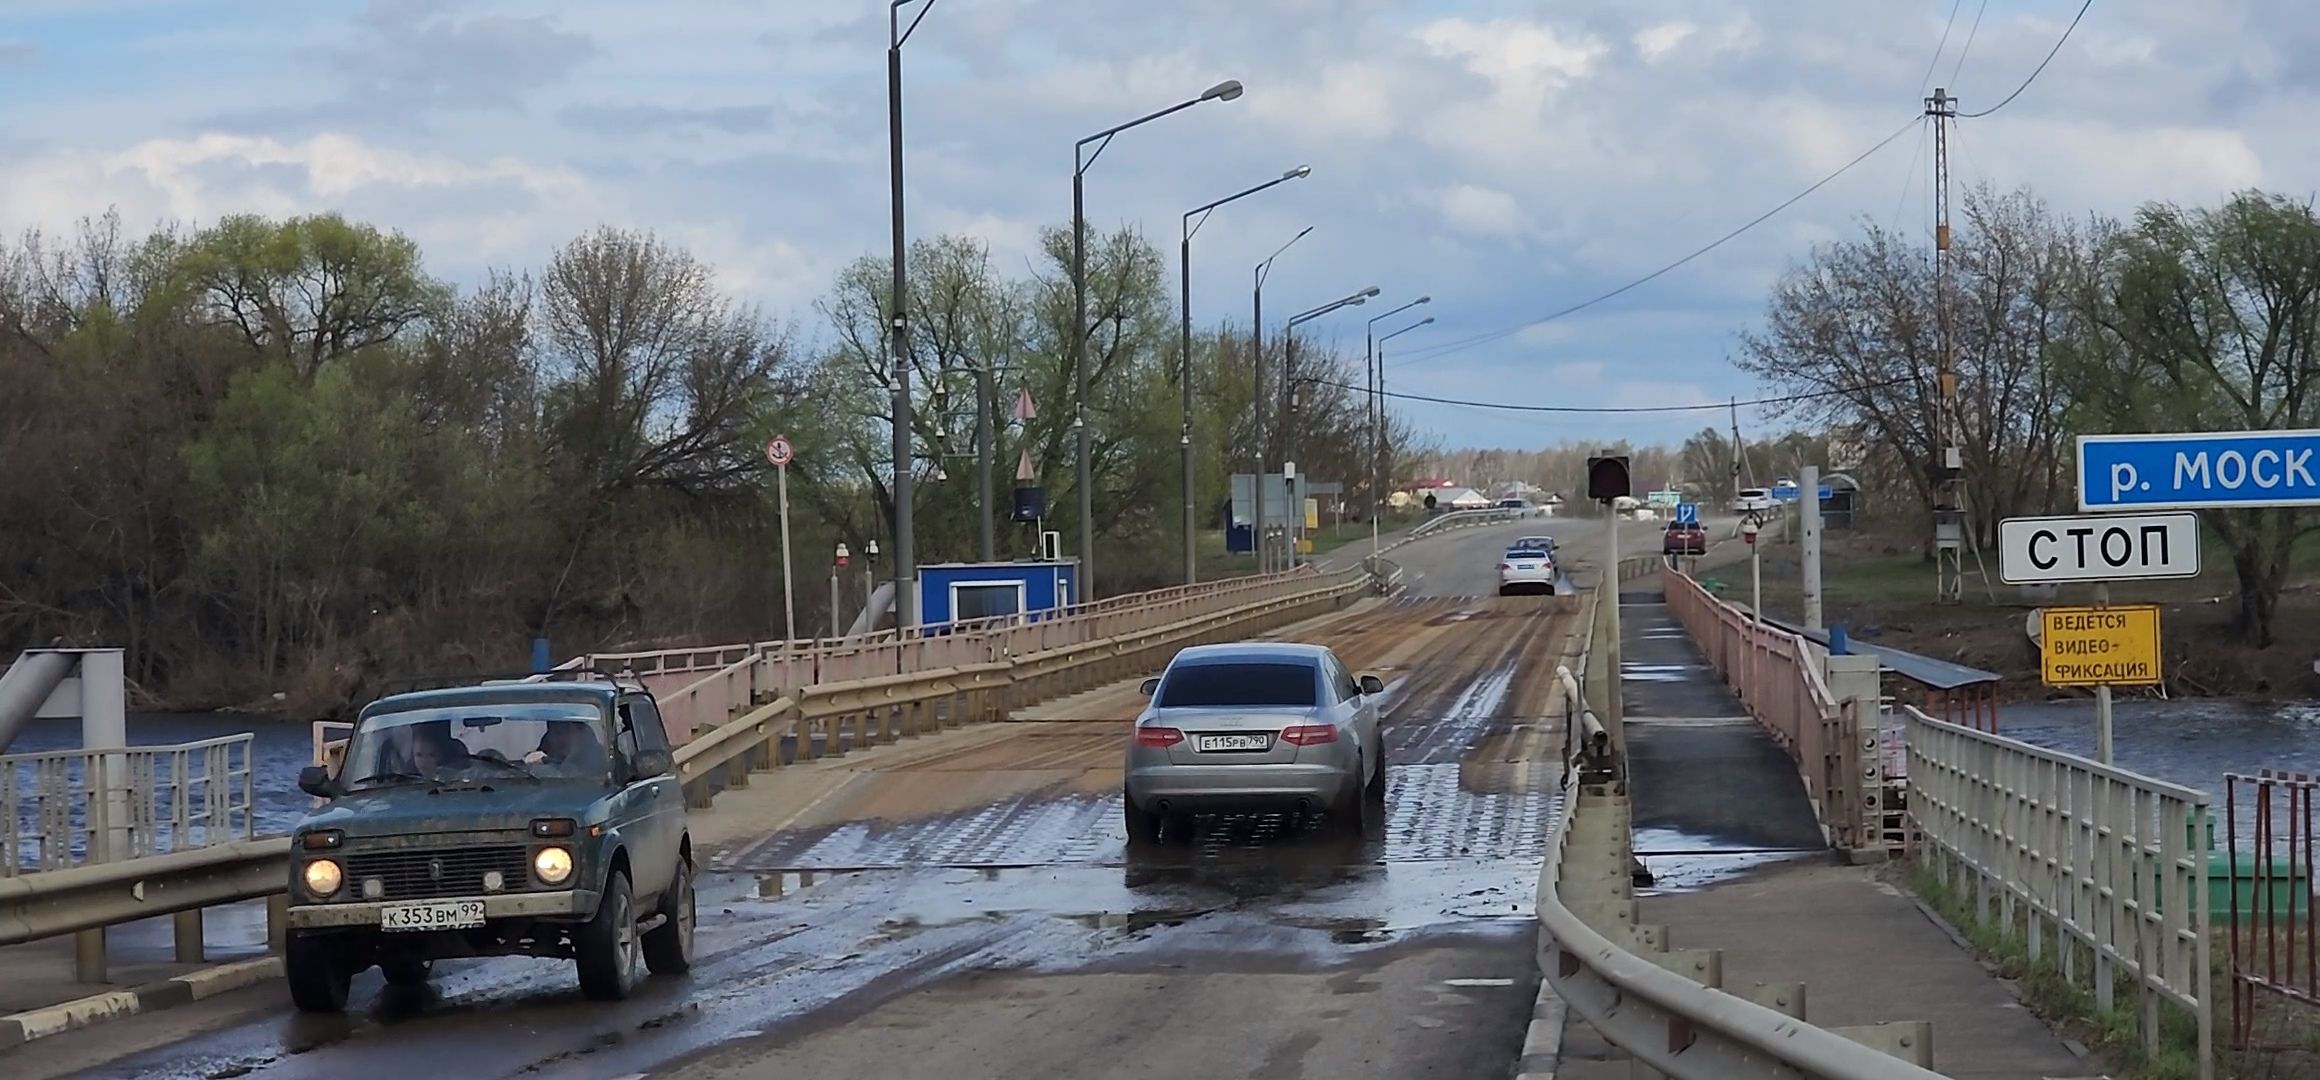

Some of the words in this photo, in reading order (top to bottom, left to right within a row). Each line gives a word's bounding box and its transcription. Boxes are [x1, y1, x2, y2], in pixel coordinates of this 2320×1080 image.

[2111, 462, 2150, 501] р.
[2028, 525, 2169, 569] СТОП
[2054, 639, 2120, 656] ВИДЕО-
[2055, 662, 2148, 679] ФИКСАЦИЯ
